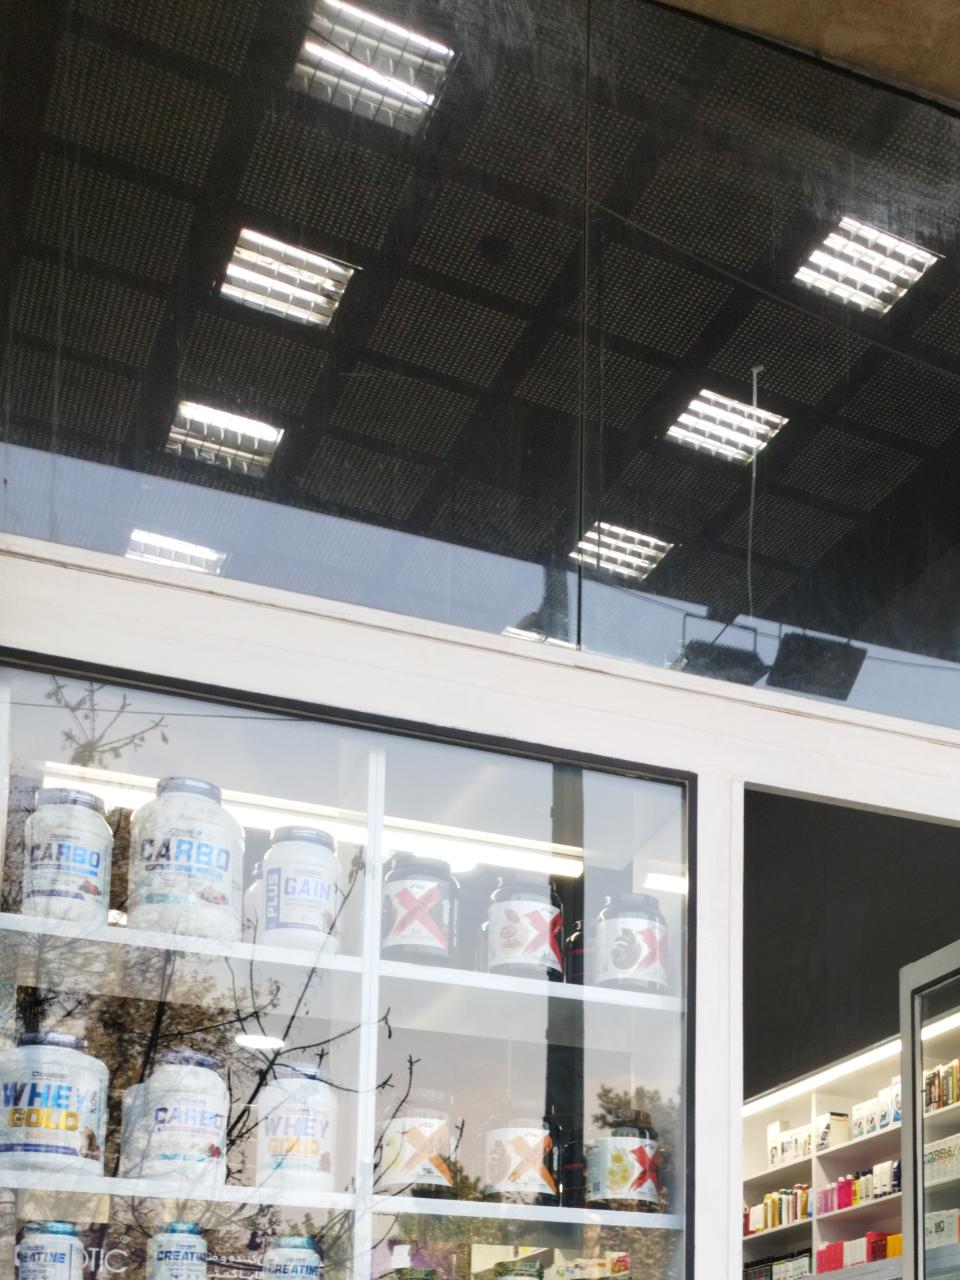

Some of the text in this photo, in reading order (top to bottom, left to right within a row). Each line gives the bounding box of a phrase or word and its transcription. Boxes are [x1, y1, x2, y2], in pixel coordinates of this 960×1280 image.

[30, 842, 101, 869] CARBO
[140, 837, 231, 872] CARBO
[267, 871, 280, 918] PLUS
[284, 876, 332, 902] GAIN
[3, 1081, 88, 1111] WHEY
[8, 1107, 79, 1132] GOLD
[154, 1107, 224, 1130] CARBO
[264, 1115, 330, 1137] WHEY
[269, 1137, 321, 1155] GOLD
